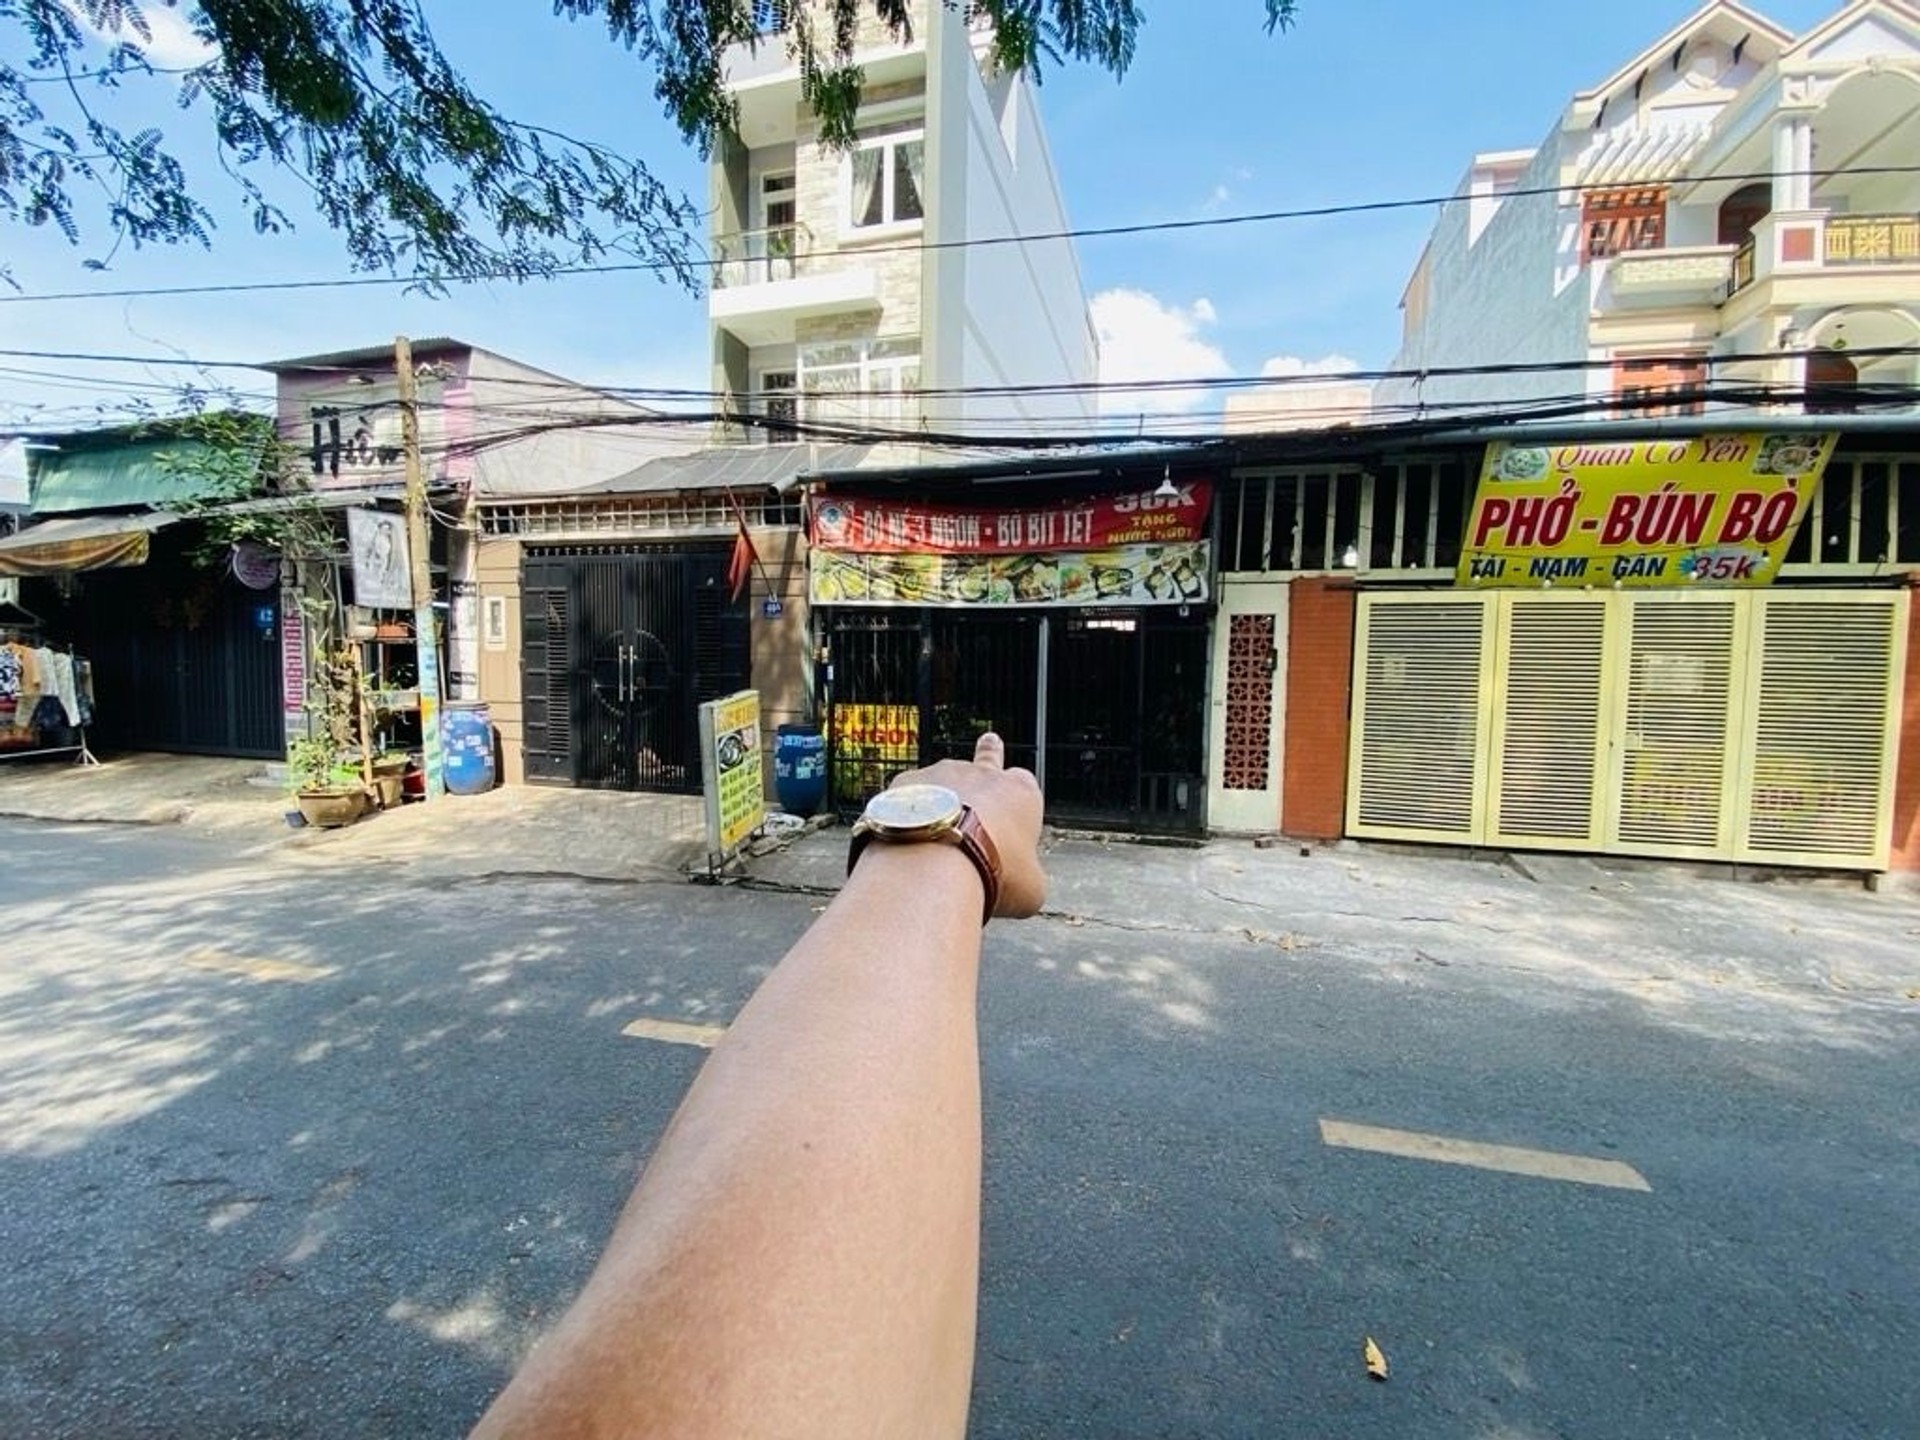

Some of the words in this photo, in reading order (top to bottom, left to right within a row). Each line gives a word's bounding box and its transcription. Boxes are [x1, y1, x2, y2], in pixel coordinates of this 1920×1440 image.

[1473, 478, 1581, 548] PHỞ
[1600, 481, 1716, 546] BÚN
[1717, 478, 1799, 544] BÒ
